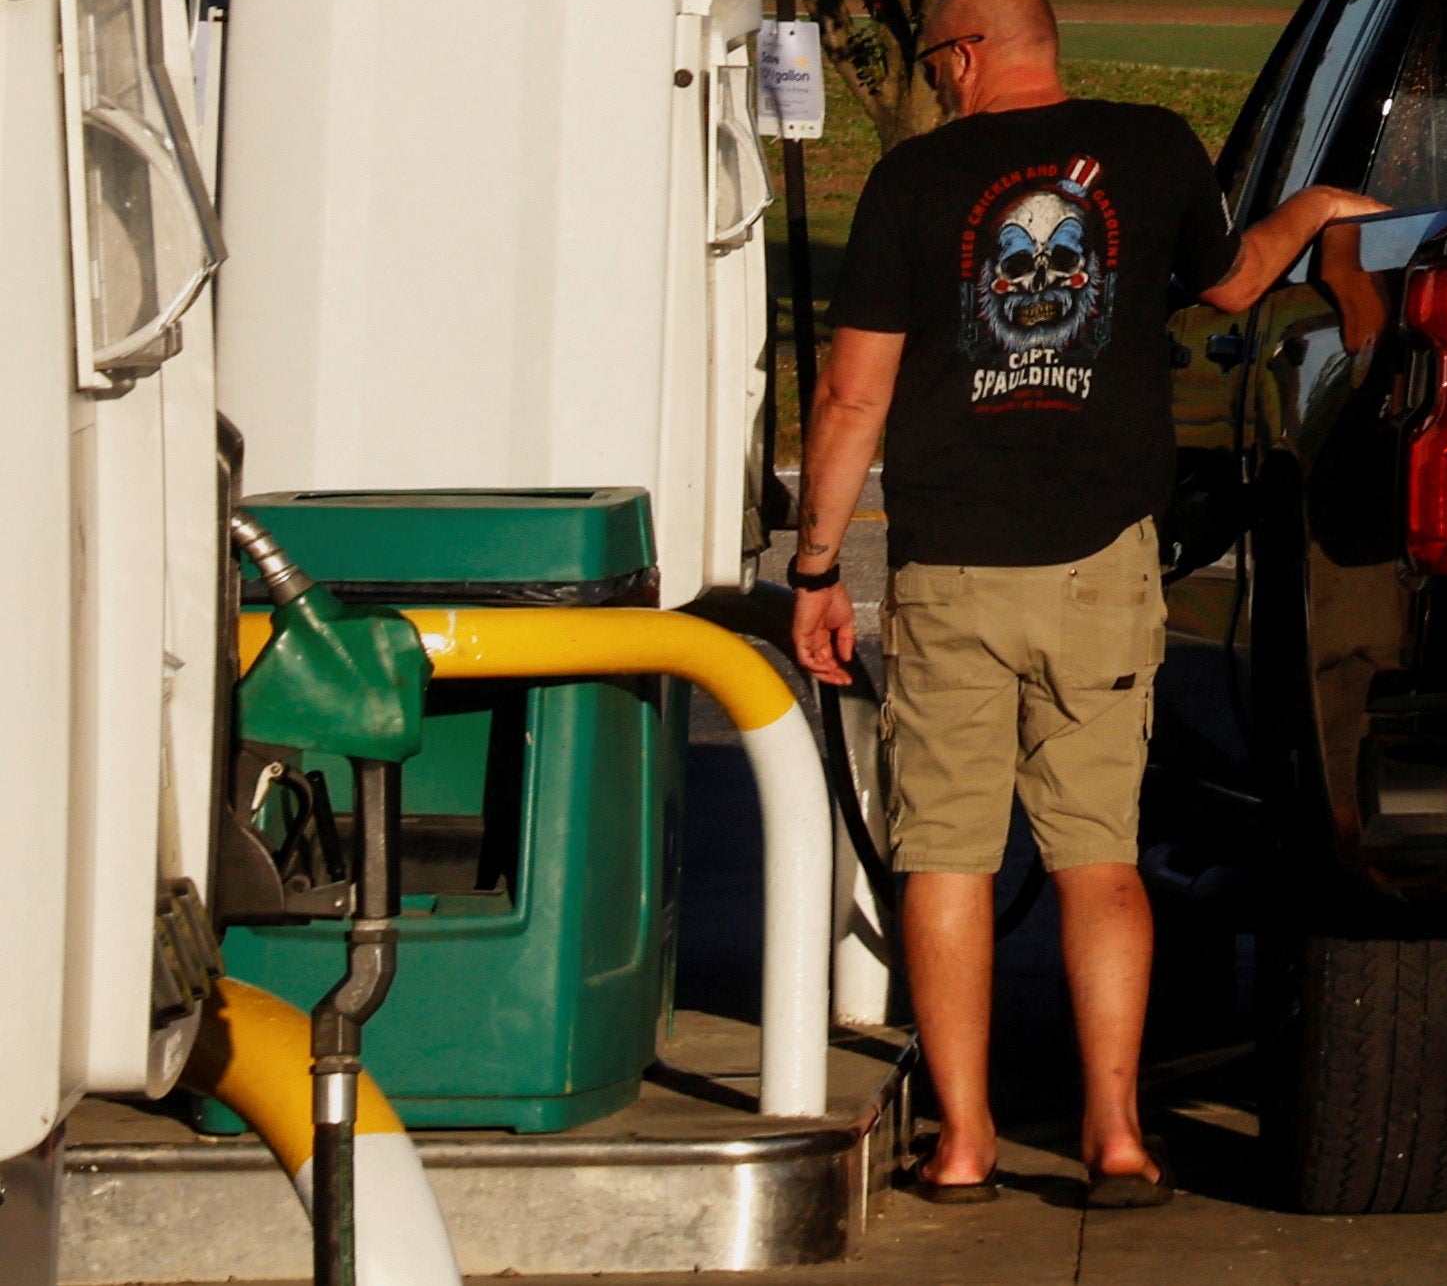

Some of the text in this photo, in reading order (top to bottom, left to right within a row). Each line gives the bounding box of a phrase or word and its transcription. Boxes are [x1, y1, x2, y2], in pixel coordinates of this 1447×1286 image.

[960, 164, 1120, 278] FRIED CHICKEN AND GASOLINE
[1008, 348, 1060, 370] CAPT.
[971, 365, 1093, 403] SPAULDING'S
